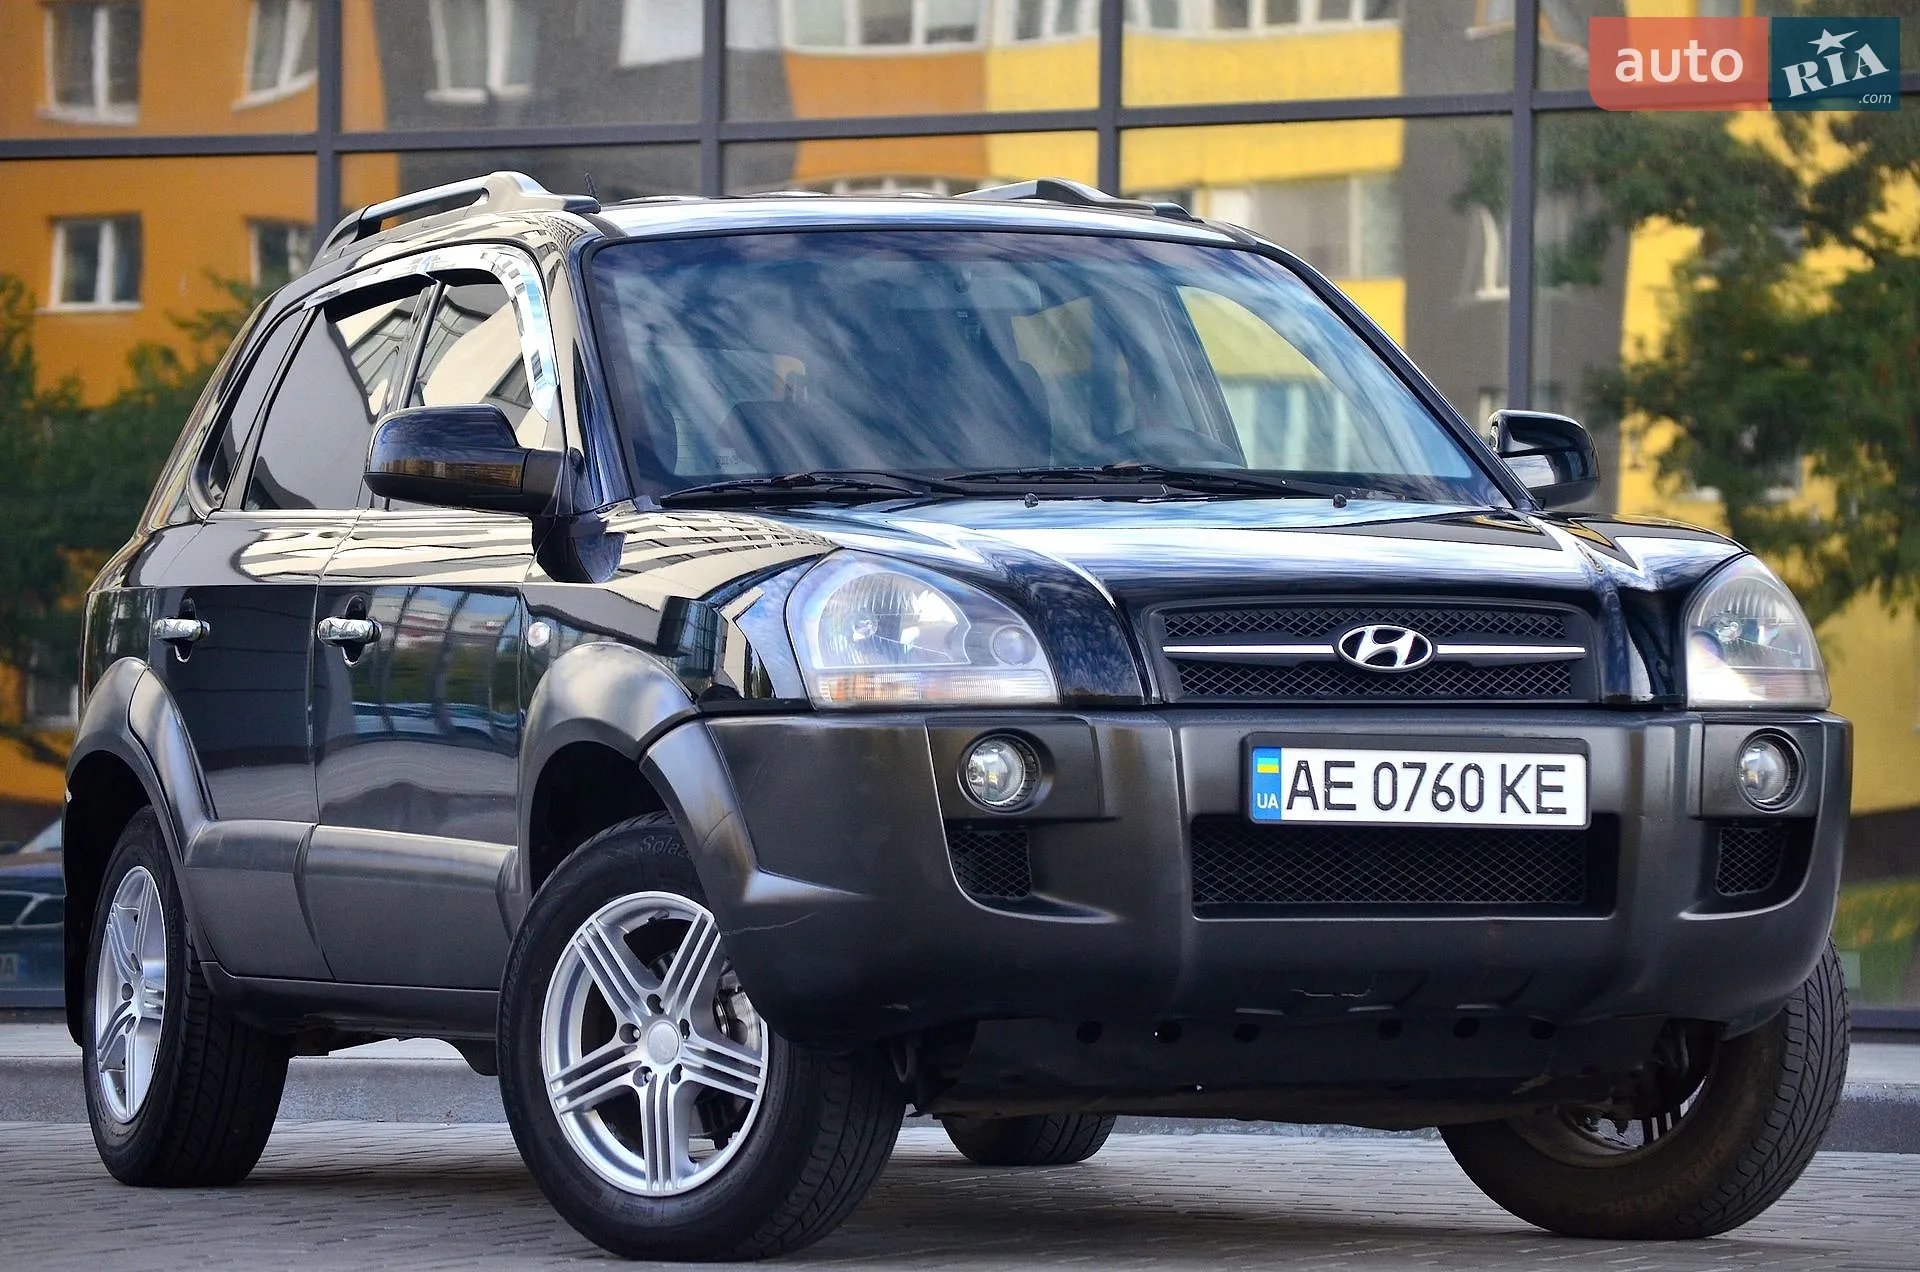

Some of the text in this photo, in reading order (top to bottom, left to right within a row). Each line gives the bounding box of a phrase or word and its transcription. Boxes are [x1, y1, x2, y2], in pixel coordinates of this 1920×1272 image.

[1256, 793, 1279, 809] UA
[1286, 760, 1568, 815] AE 0760 KE
